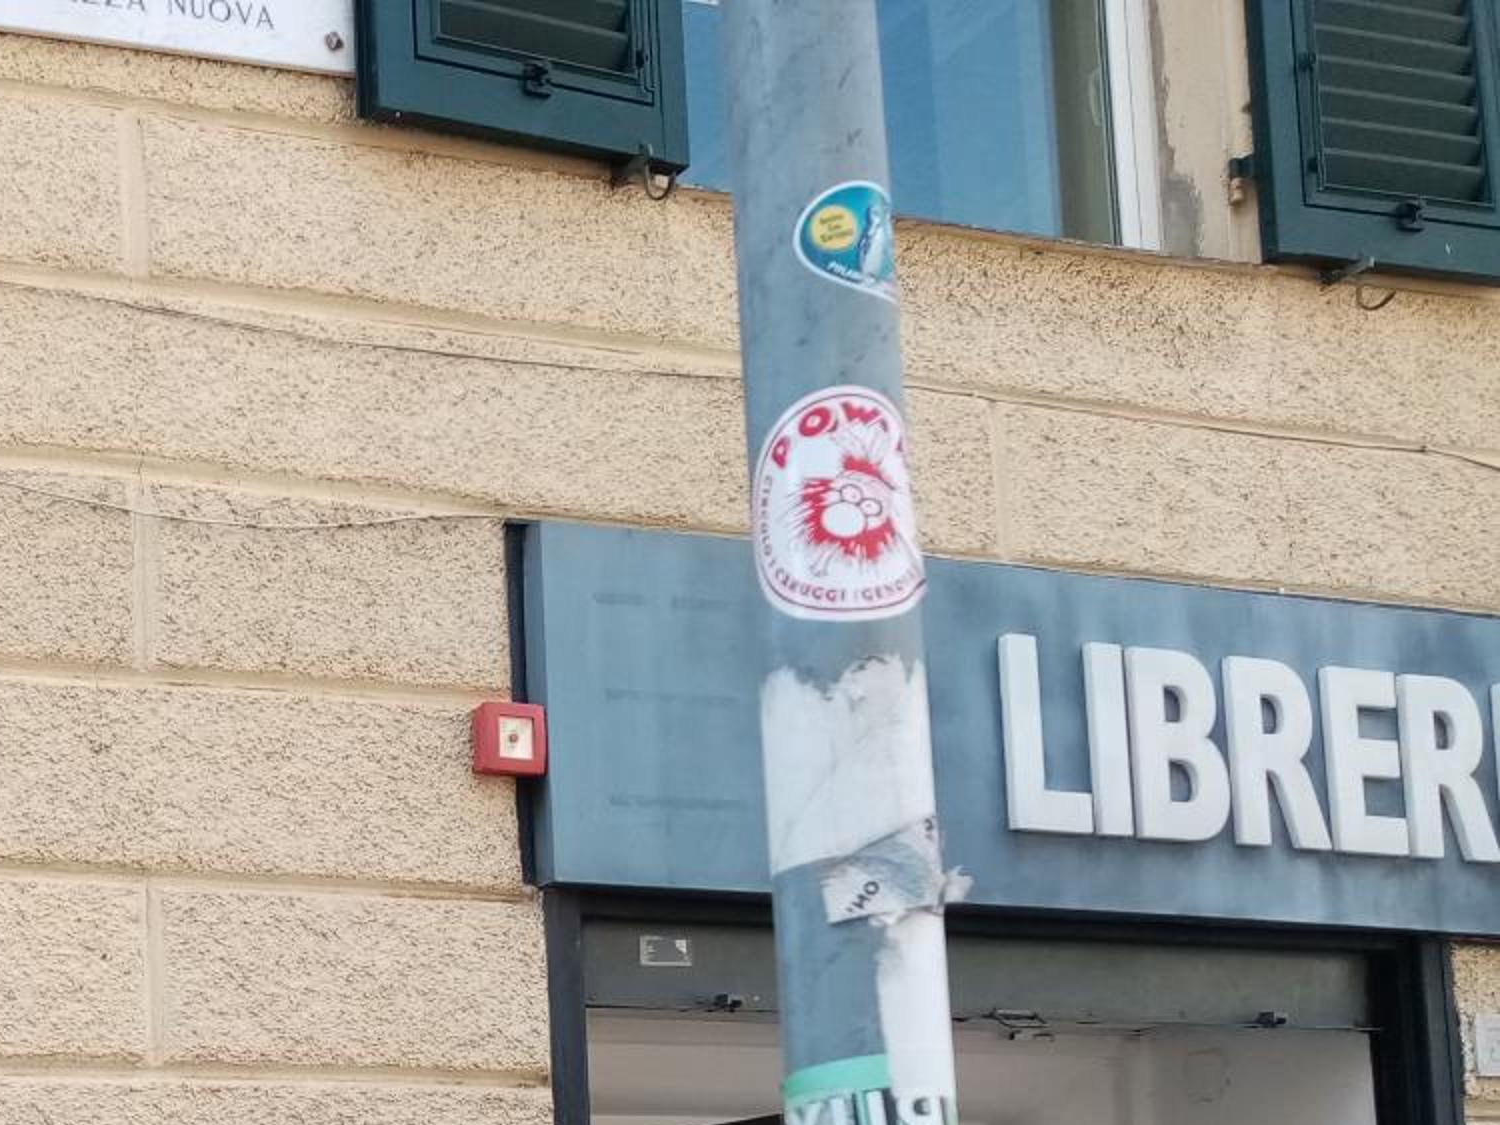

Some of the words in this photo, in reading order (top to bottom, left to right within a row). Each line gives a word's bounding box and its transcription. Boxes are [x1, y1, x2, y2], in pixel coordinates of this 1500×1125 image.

[168, 0, 275, 30] NUOVA
[775, 567, 846, 601] CARUGGI
[997, 632, 1500, 863] LIBRER
